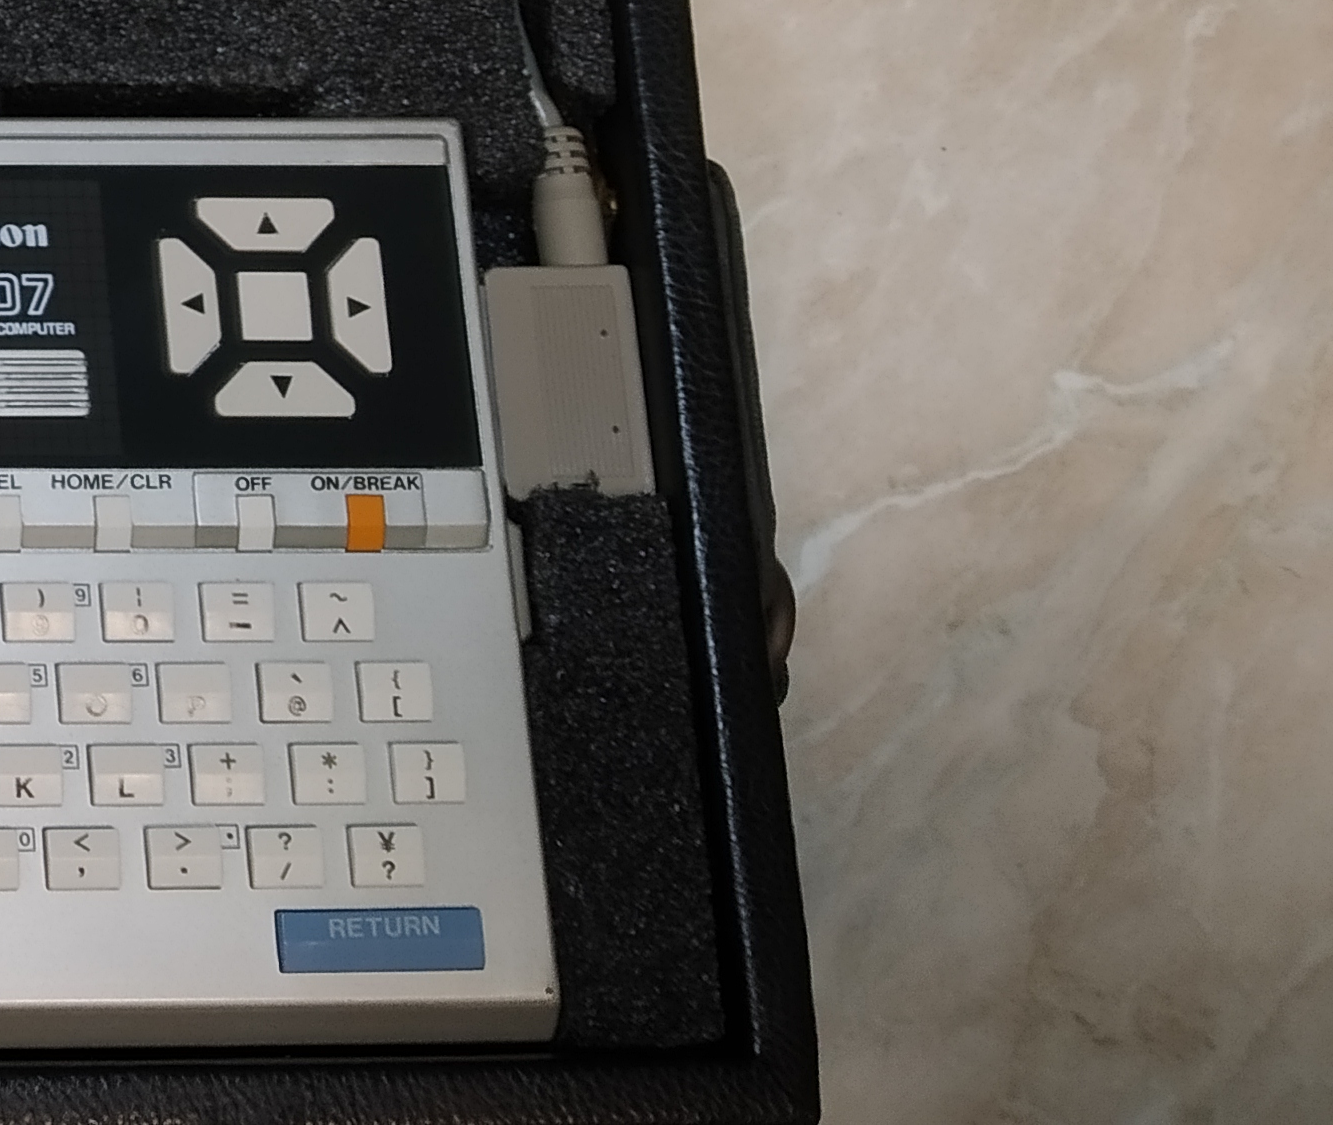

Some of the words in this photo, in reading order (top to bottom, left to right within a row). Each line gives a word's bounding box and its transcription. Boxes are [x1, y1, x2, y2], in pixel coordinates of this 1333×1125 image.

[51, 474, 172, 490] HOME/CLR
[235, 476, 272, 491] OFF
[310, 476, 421, 491] ON/BREAK
[38, 588, 45, 608] )
[75, 588, 86, 602] 9
[232, 592, 249, 605] =
[31, 668, 43, 683] 5
[132, 668, 143, 682] 6
[288, 696, 307, 716] @
[392, 696, 403, 717] [
[63, 750, 74, 764] 2
[165, 749, 176, 763] 3
[219, 752, 236, 770] +
[15, 777, 35, 798] K
[118, 777, 134, 798] L
[425, 776, 435, 800] ]
[73, 833, 91, 852] <
[174, 831, 192, 851] >
[278, 832, 292, 850] ?
[377, 831, 395, 852] ¥
[280, 862, 292, 880] /
[382, 860, 395, 880] ?
[329, 915, 440, 938] RETURN
